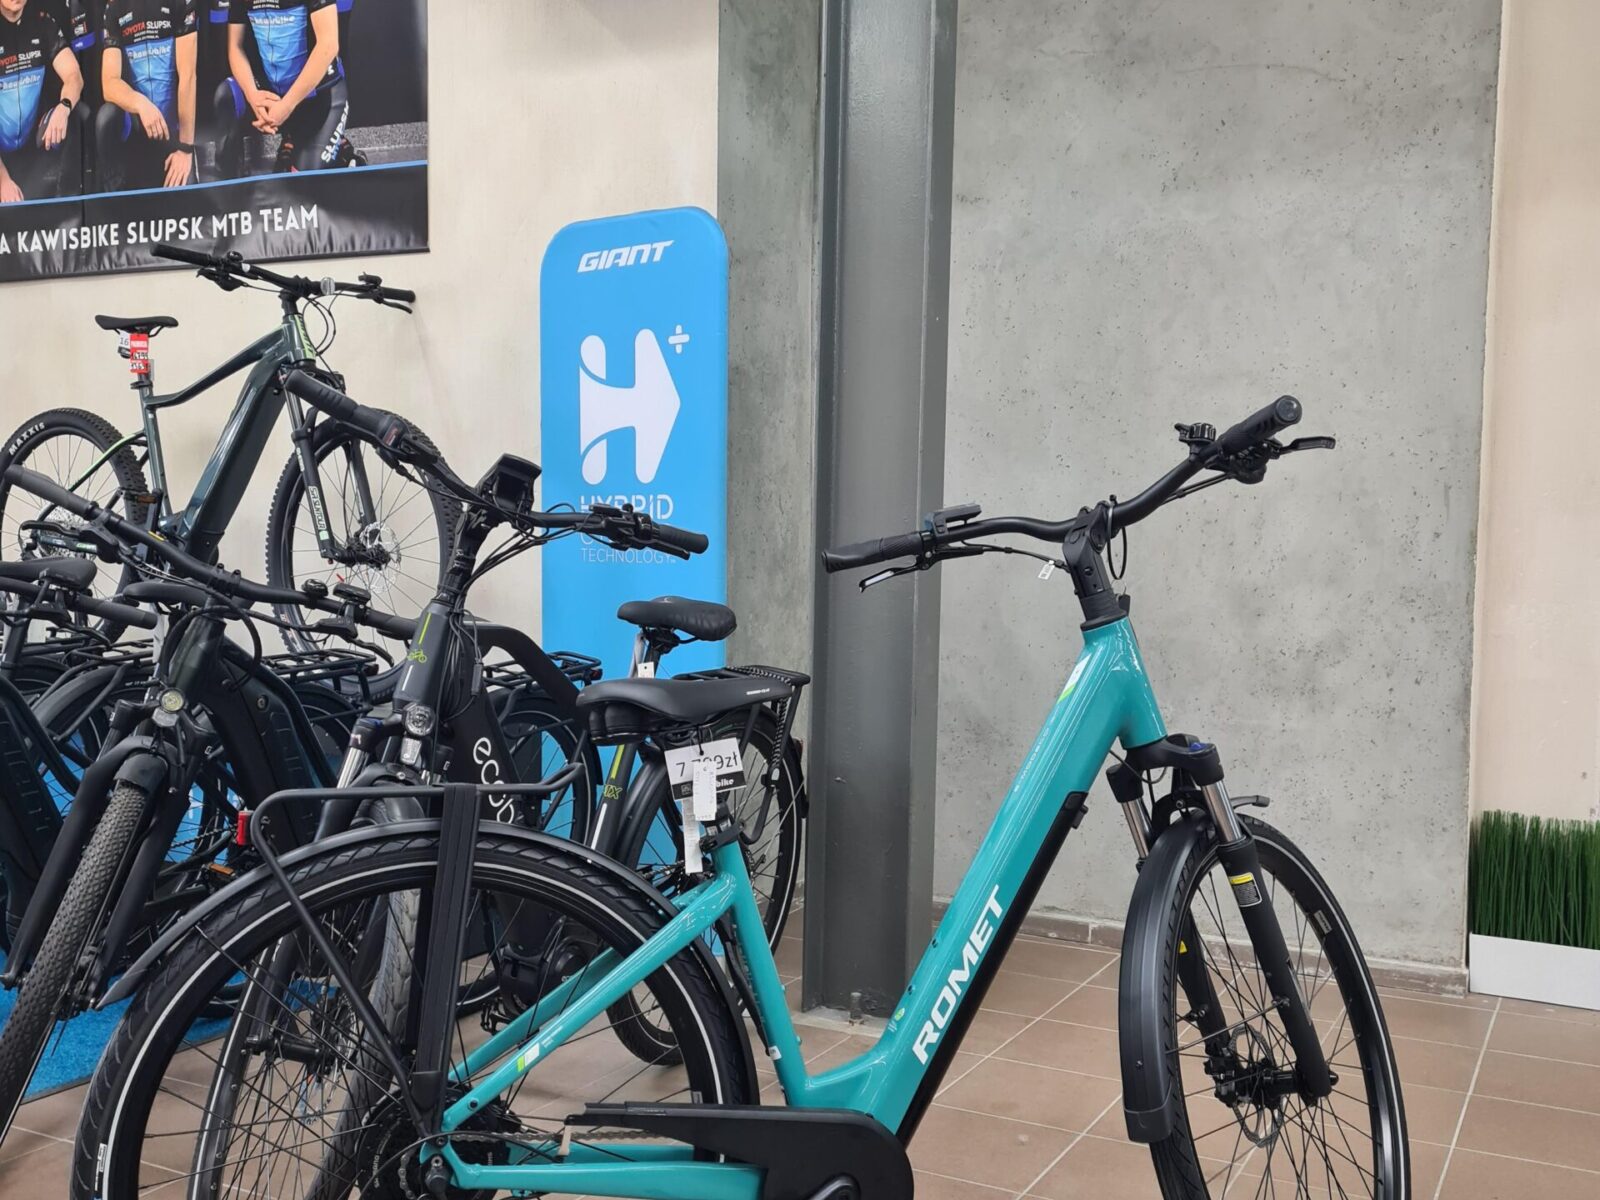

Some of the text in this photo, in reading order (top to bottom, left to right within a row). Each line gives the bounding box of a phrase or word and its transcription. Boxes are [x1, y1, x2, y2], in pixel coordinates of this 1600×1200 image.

[17, 223, 119, 253] KAWISBIKE
[126, 216, 204, 245] SLUPSK
[212, 211, 252, 238] MTB
[259, 203, 318, 233] TEAM
[577, 239, 675, 273] GIANT
[8, 421, 46, 456] MAXXIS
[911, 883, 1004, 1066] ROMET
